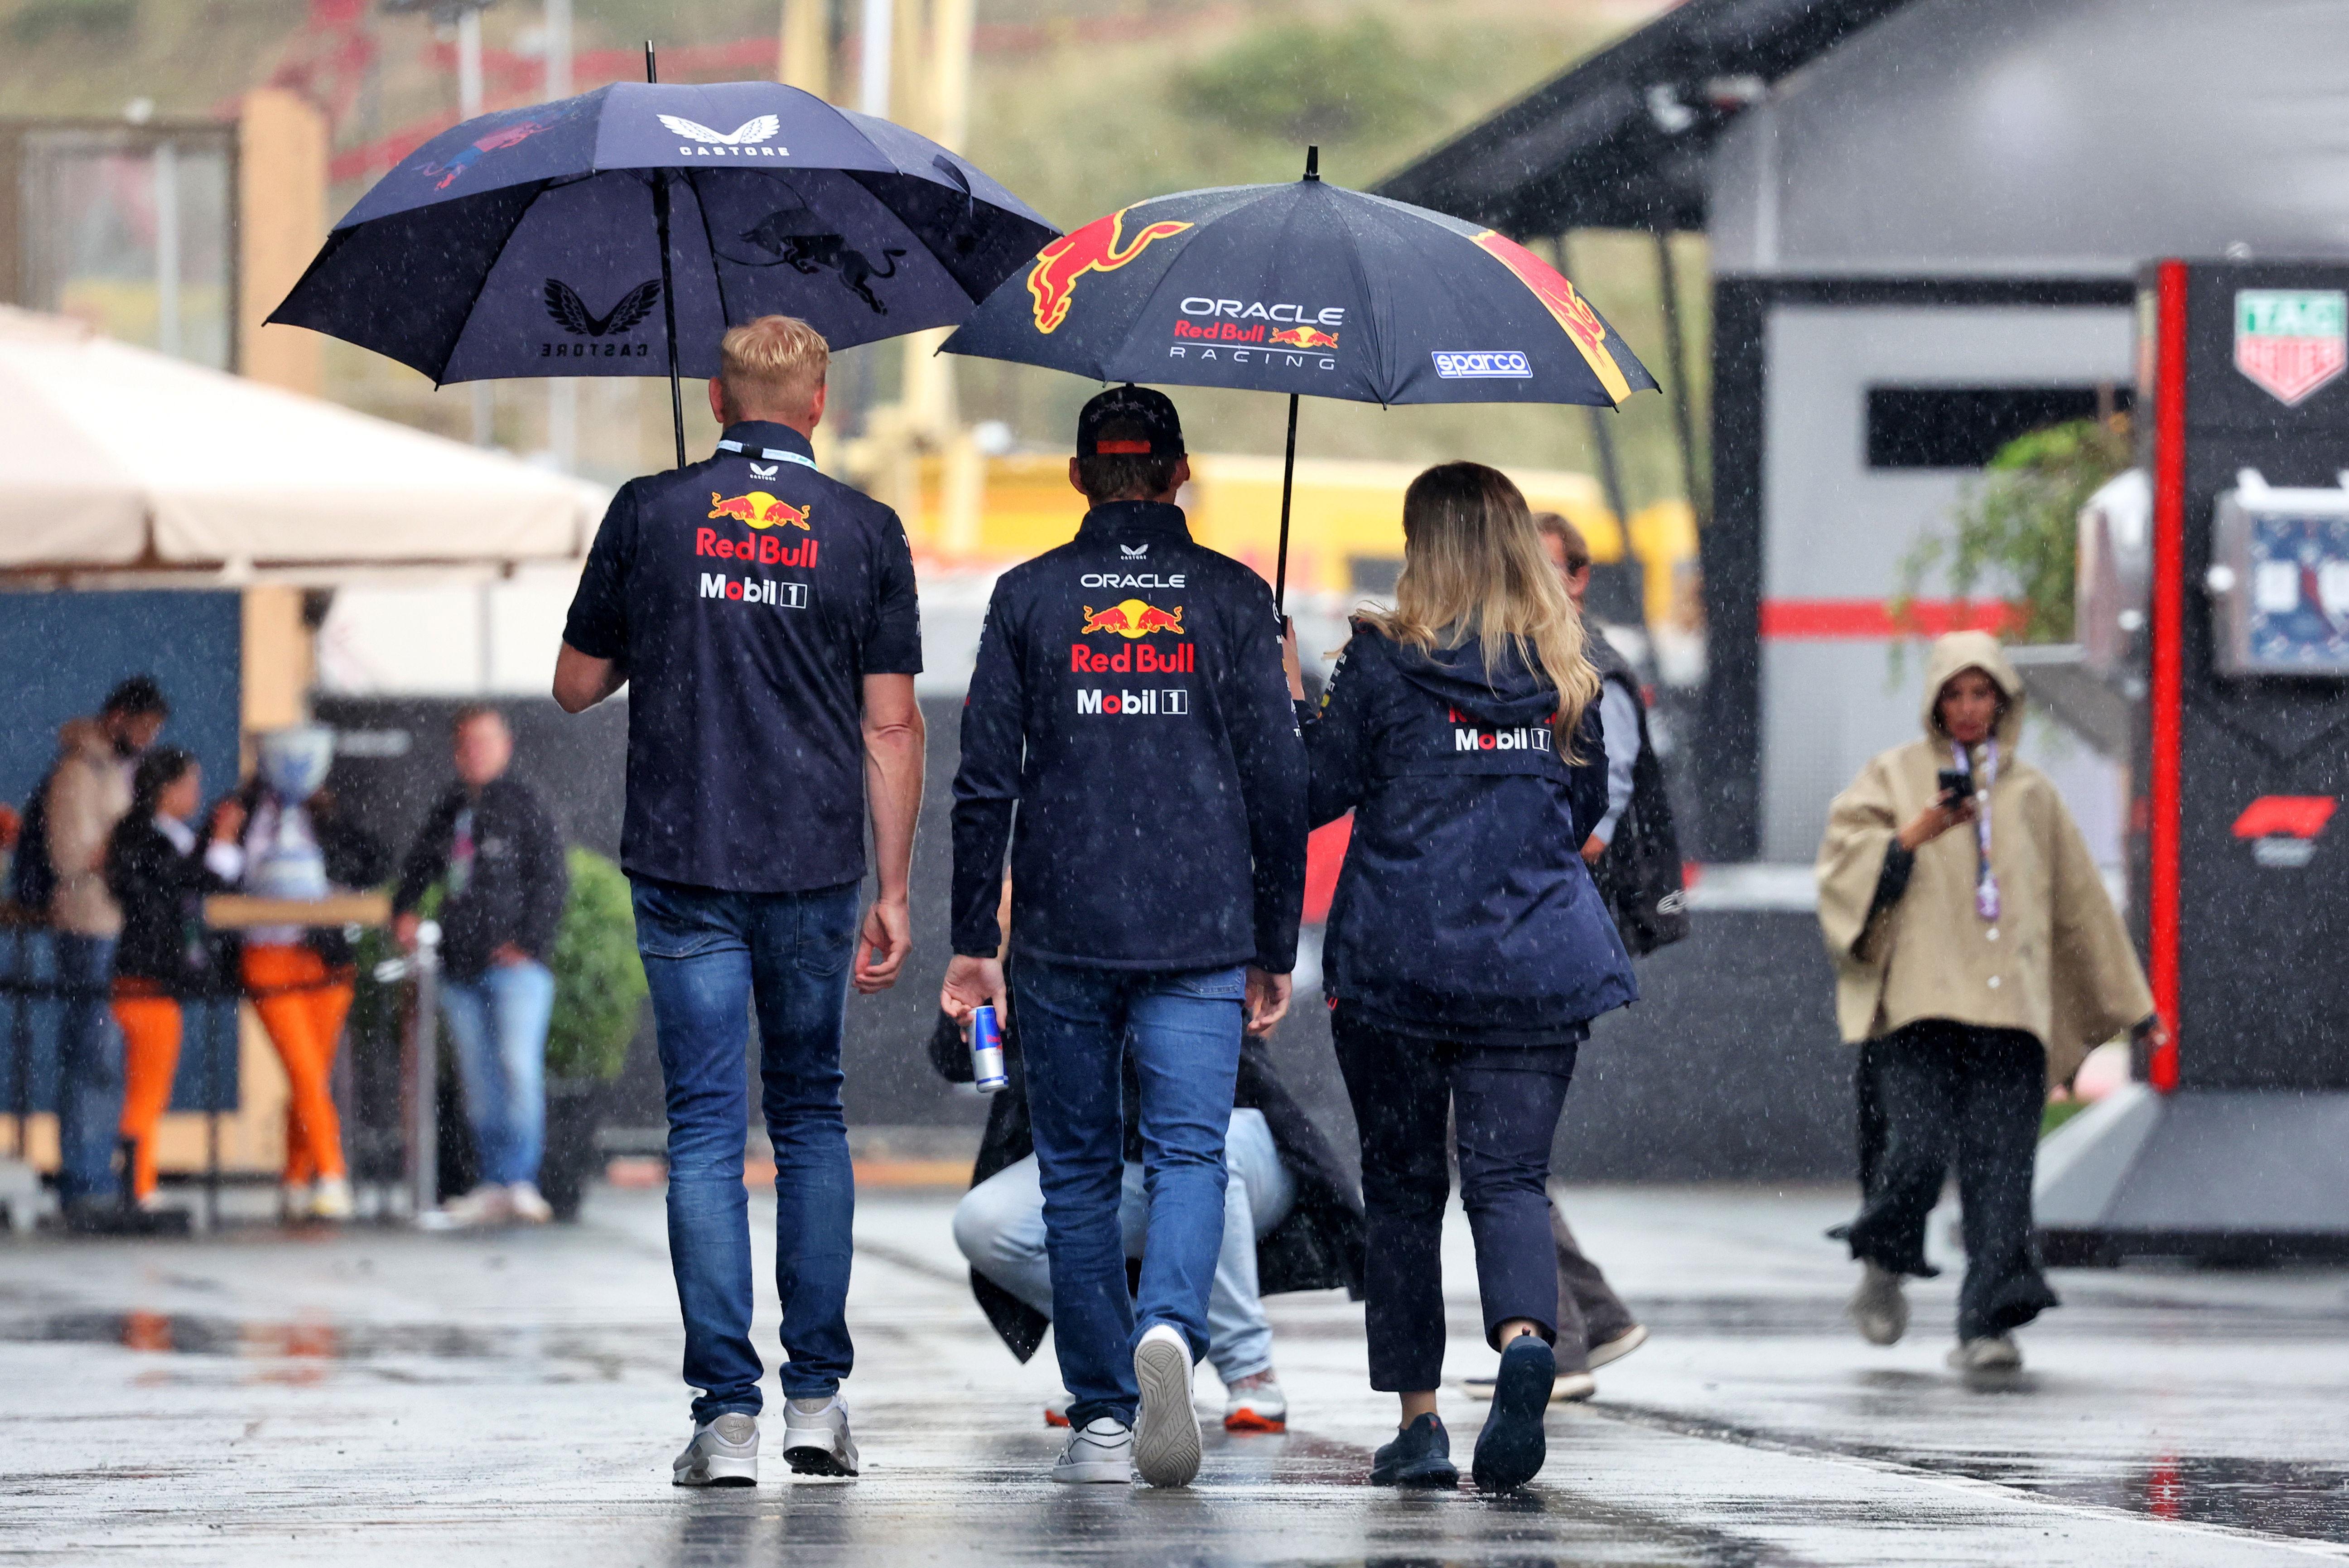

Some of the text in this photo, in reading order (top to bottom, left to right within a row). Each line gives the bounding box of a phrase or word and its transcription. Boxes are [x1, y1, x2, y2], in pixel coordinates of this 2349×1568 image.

[679, 146, 790, 156] CASTORE
[1180, 297, 1346, 326] ORACLE
[1174, 319, 1265, 343] Red Bull
[1169, 346, 1335, 370] RACING
[1437, 354, 1526, 376] sparco
[696, 527, 819, 568] Red Bull
[700, 572, 777, 605] Mobil
[1080, 574, 1186, 589] ORACLE
[1071, 642, 1194, 673] Red Bull
[1077, 689, 1157, 715] Mobil
[1455, 727, 1528, 751] Mobil
